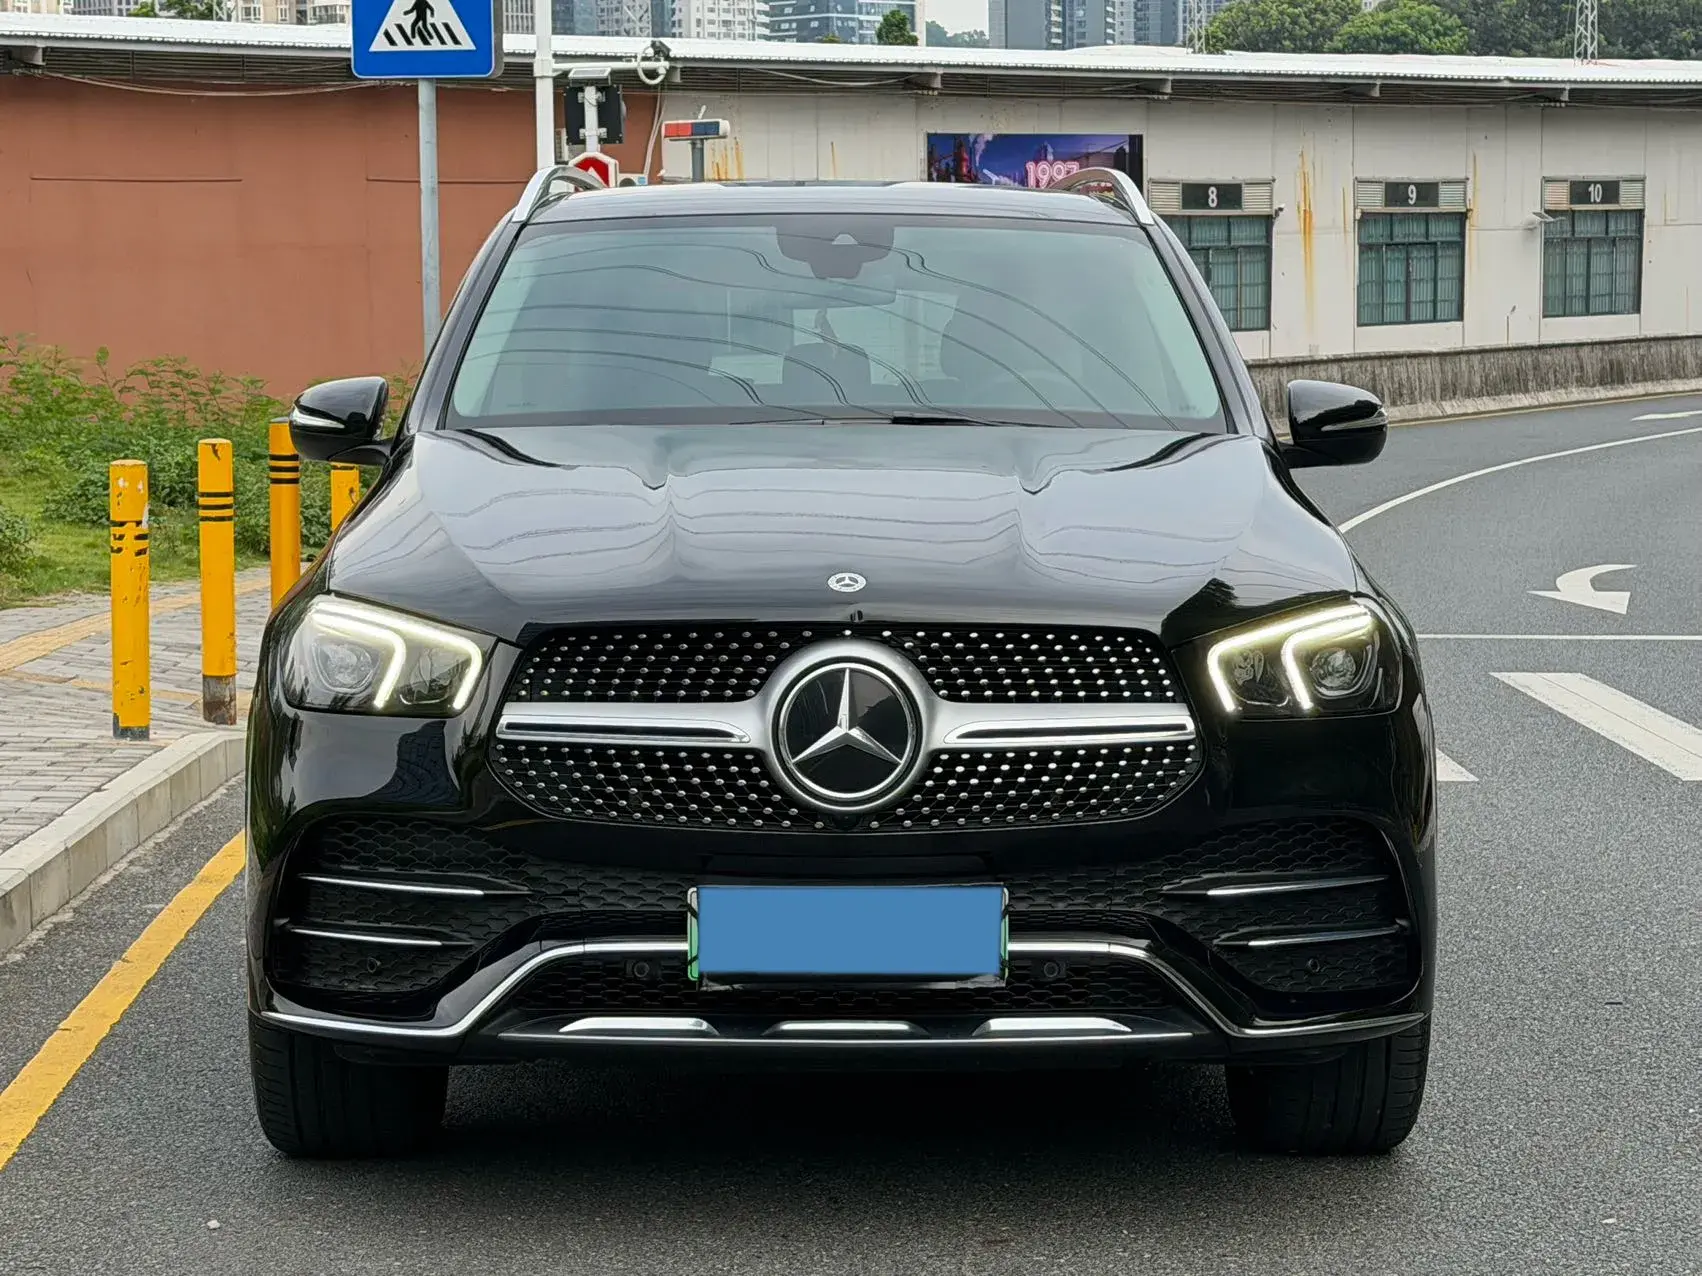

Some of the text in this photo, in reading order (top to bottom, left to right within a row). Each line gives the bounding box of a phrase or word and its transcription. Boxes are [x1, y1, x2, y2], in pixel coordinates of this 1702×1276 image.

[1208, 186, 1218, 208] 8
[1408, 184, 1417, 205] 9
[1588, 183, 1603, 203] 10
